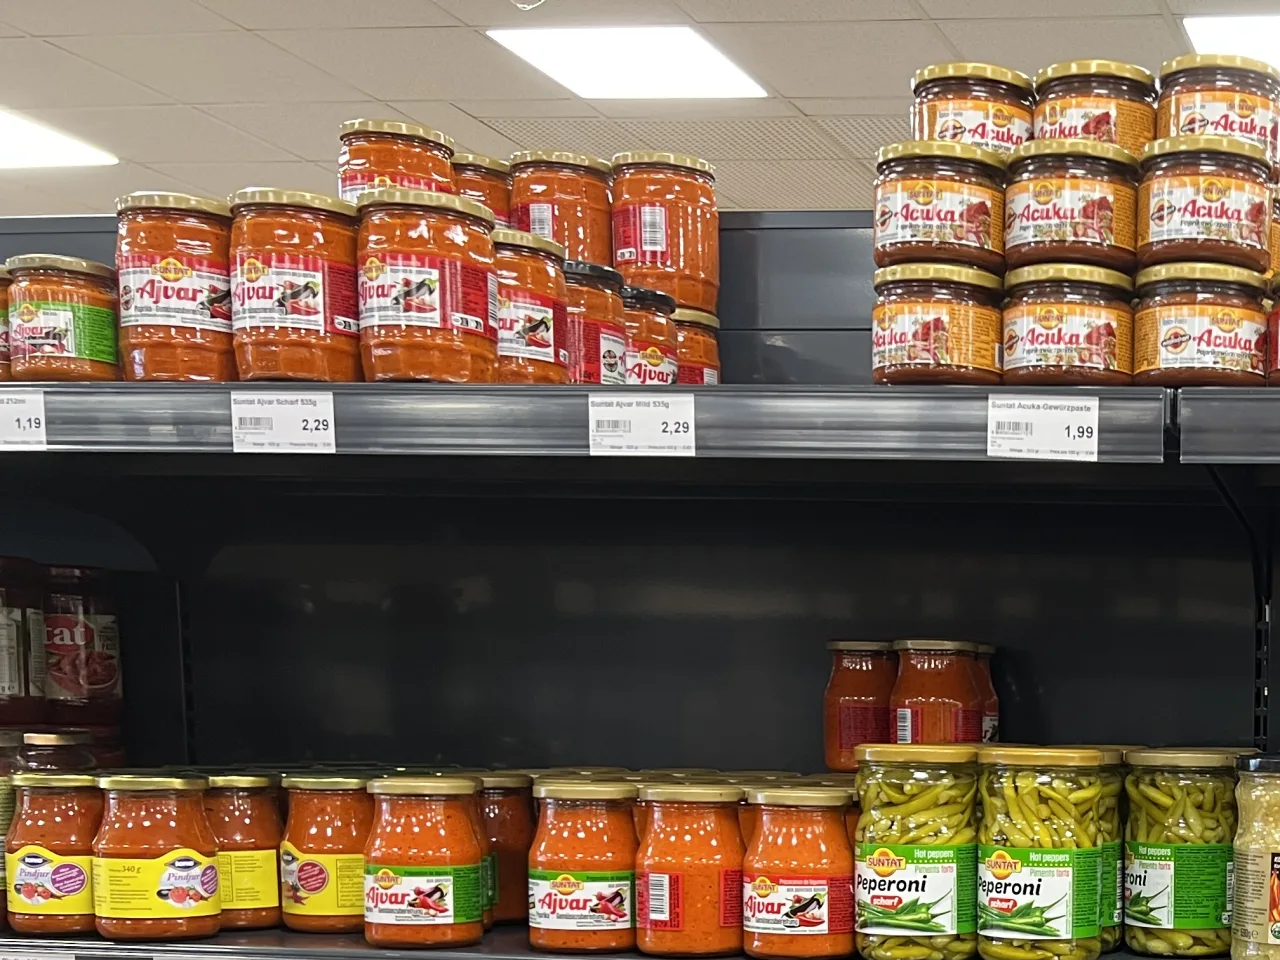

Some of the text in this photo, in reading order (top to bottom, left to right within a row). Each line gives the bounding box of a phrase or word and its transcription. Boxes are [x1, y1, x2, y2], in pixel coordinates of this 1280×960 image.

[1210, 117, 1268, 141] Acuka
[894, 204, 957, 223] Acuka
[1017, 204, 1077, 223] Acuka
[1178, 200, 1242, 221] Acuka
[151, 265, 192, 277] SUNTAT
[136, 279, 203, 303] Ajvar
[1020, 329, 1081, 348] Acuka
[1193, 329, 1253, 351] Acuka
[257, 399, 274, 408] Ajvar
[15, 417, 41, 430] 1,19
[301, 419, 329, 433] 2,29
[661, 421, 689, 435] 2,29
[1065, 426, 1093, 439] 1,99
[915, 849, 954, 860] Hot peppers
[866, 857, 905, 869] SUNTAT
[985, 859, 1020, 872] SUNTAT
[19, 867, 50, 880] Pindjur
[167, 872, 201, 884] Pindjur
[857, 874, 928, 896] Peperoni
[365, 890, 410, 910] Ajvar
[538, 894, 593, 911] Ajvar
[744, 898, 786, 915] Ajvar
[872, 896, 900, 908] scharf
